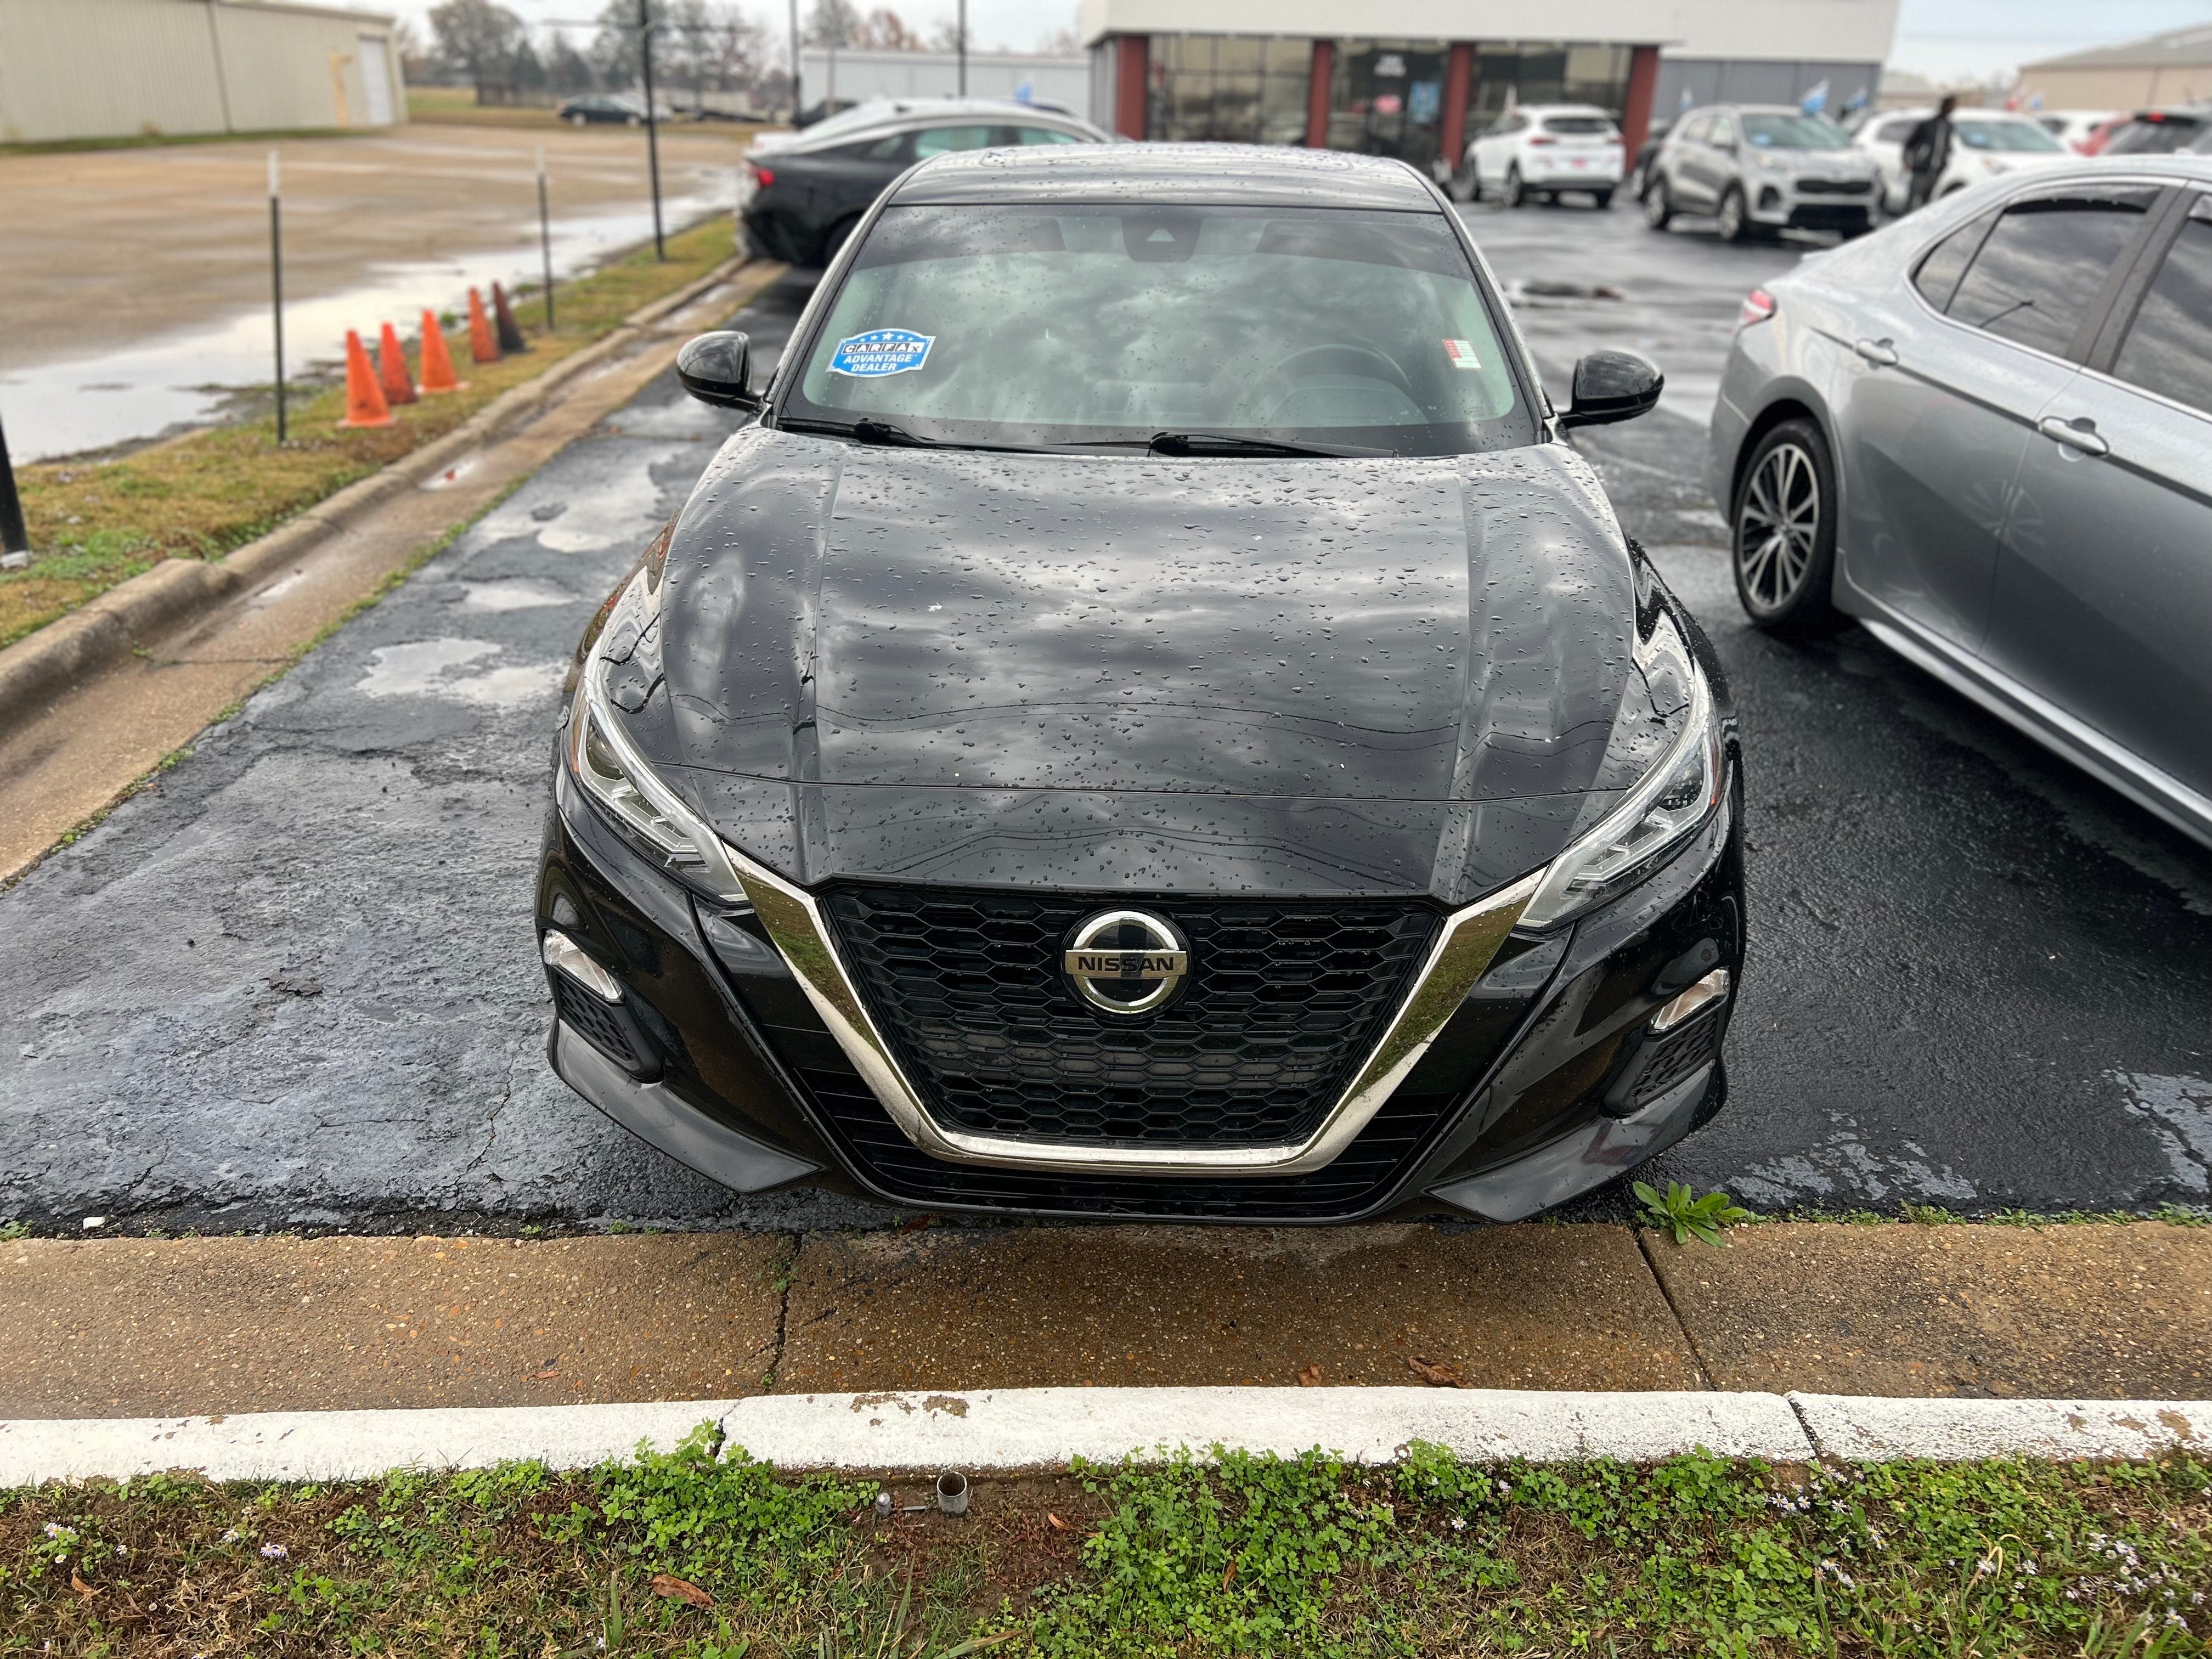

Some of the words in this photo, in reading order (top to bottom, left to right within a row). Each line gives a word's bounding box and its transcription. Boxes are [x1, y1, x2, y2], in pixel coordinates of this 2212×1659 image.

[844, 343, 921, 353] CARFAX
[843, 354, 912, 363] ADVANTAGE
[851, 363, 897, 371] DEALER
[1079, 956, 1173, 971] NISSAN
